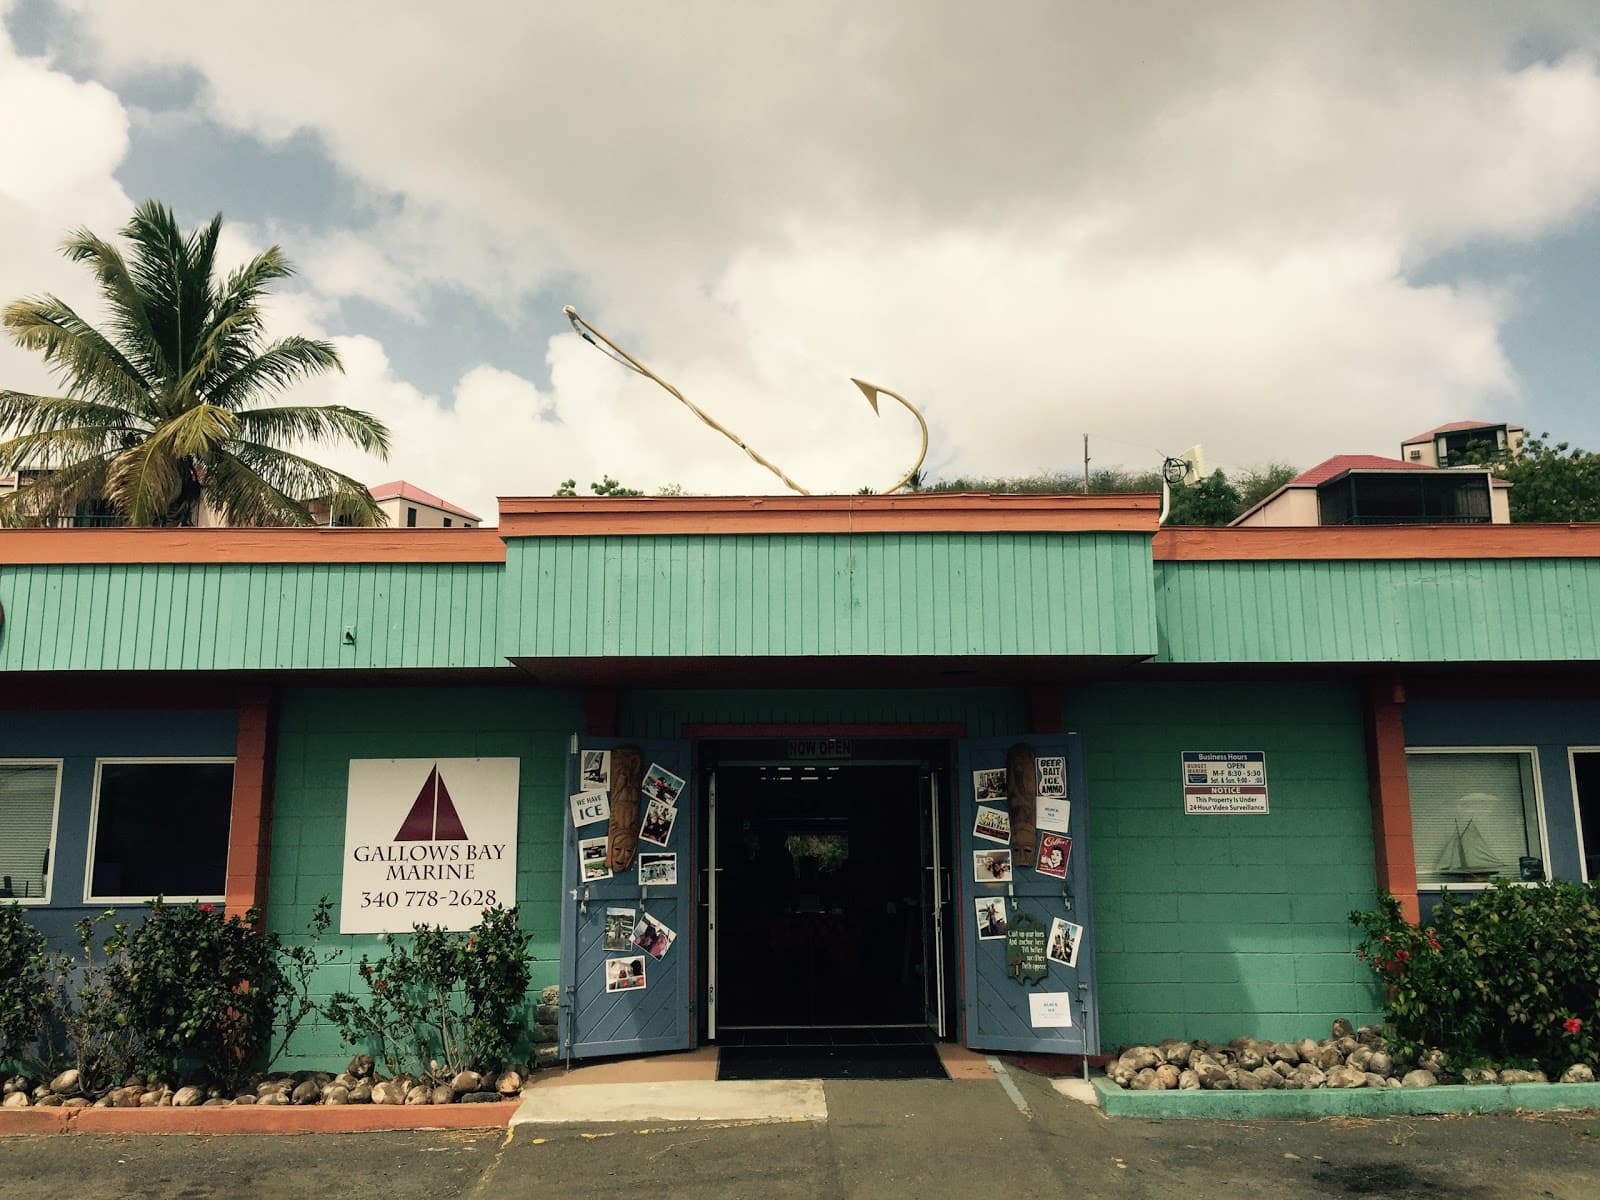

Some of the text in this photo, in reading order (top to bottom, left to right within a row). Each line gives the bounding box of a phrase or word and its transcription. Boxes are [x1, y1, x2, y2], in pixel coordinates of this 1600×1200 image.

[819, 741, 850, 754] OPEN
[1198, 753, 1248, 761] Business Hours
[1040, 759, 1062, 767] BEER
[1042, 767, 1061, 776] BAIT
[1044, 777, 1060, 785] ICE
[1041, 785, 1063, 793] AMMO
[586, 795, 602, 803] HAVE
[579, 804, 603, 820] ICE
[354, 844, 507, 863] GALLOWS BAY
[386, 863, 475, 881] MARINE
[360, 889, 497, 908] 340 778-2628
